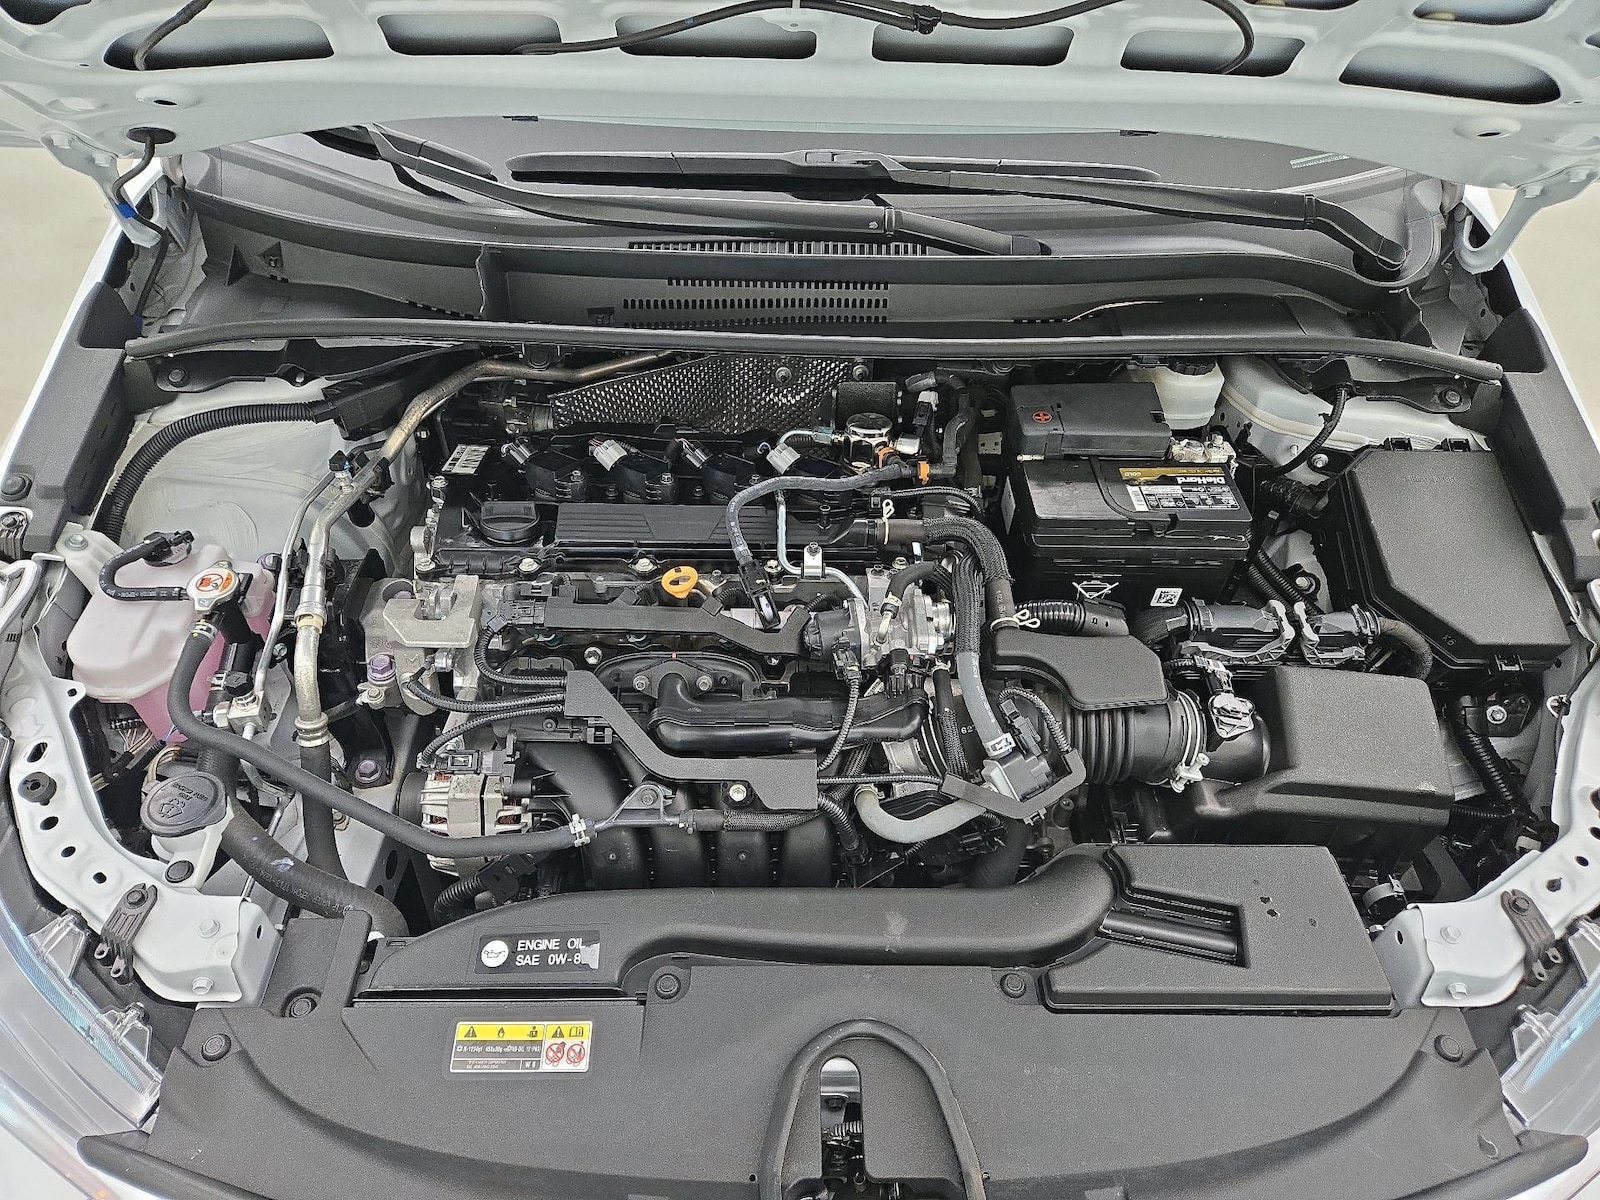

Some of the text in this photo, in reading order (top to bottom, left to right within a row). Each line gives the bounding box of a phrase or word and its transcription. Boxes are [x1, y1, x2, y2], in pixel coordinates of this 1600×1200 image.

[1176, 476, 1226, 485] DieHard
[516, 938, 586, 951] ENGINE OIL
[515, 954, 541, 966] SAE
